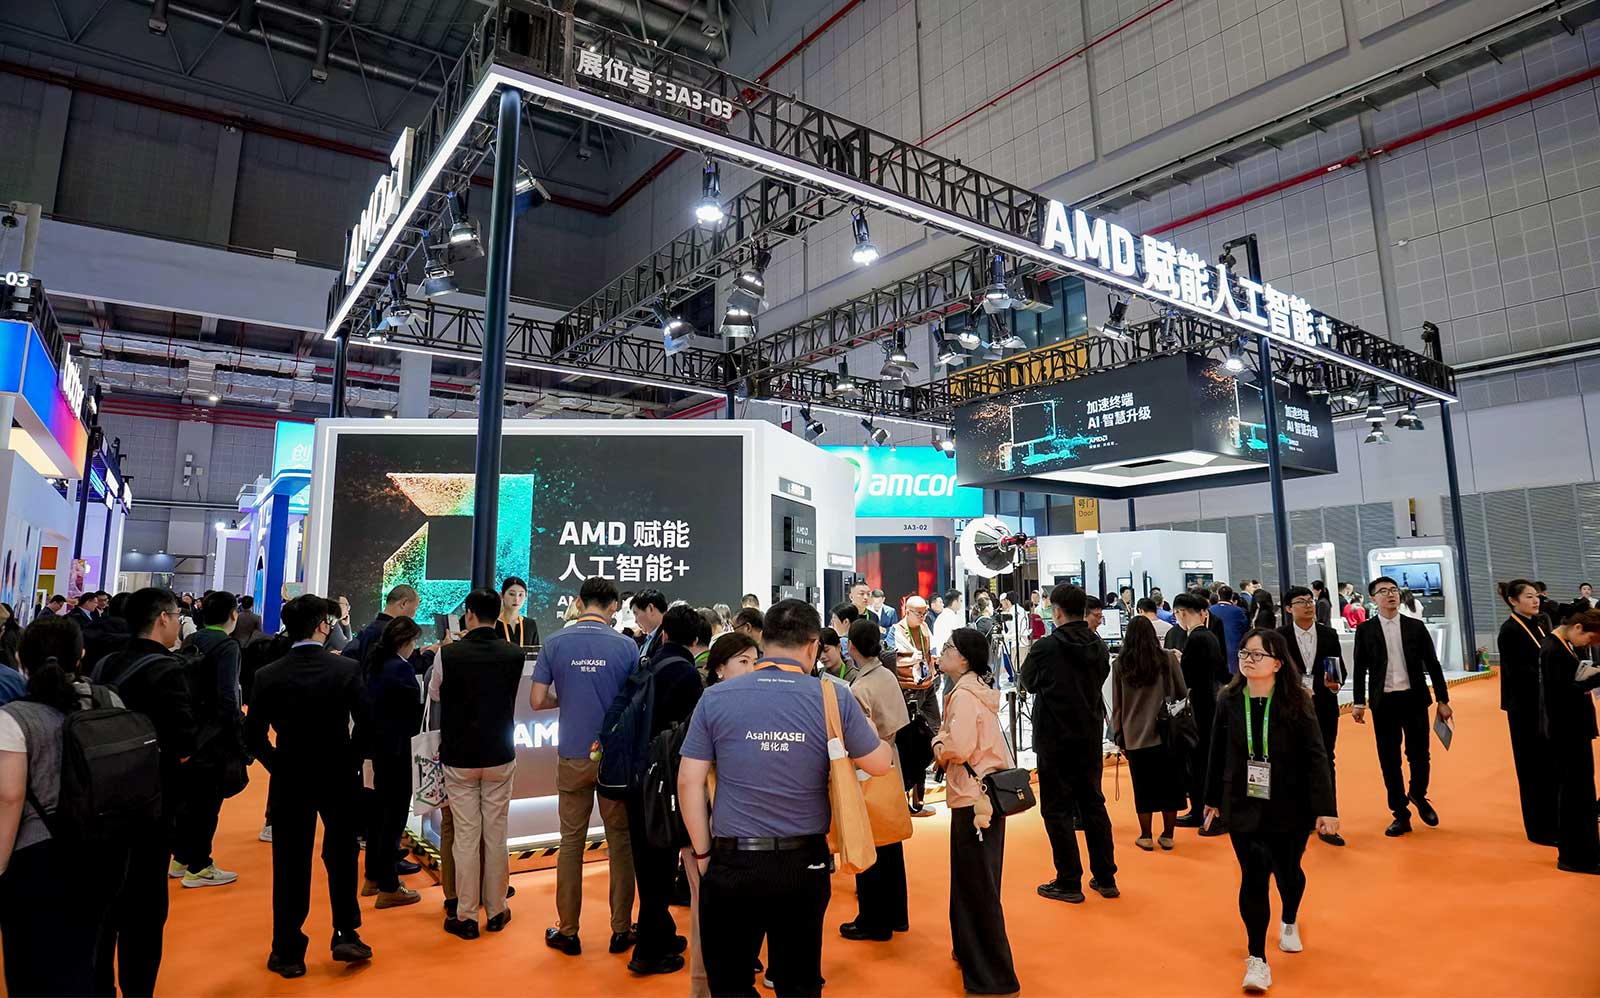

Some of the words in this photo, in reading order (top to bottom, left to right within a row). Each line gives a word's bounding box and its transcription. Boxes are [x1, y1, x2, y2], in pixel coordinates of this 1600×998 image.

[1041, 199, 1135, 277] AMD
[1142, 234, 1333, 346] 赋能人工智能+
[1086, 392, 1134, 415] 加速终端
[1088, 416, 1100, 429] AI
[1102, 406, 1152, 427] 智慧升级
[868, 474, 957, 497] amcor
[559, 521, 626, 546] AMD
[633, 520, 691, 548] 赋能
[558, 553, 690, 582] 人工智能+
[570, 659, 606, 667] AsahiKASEI
[745, 731, 805, 742] AsahiKASEI
[760, 742, 790, 752] 旭化成
